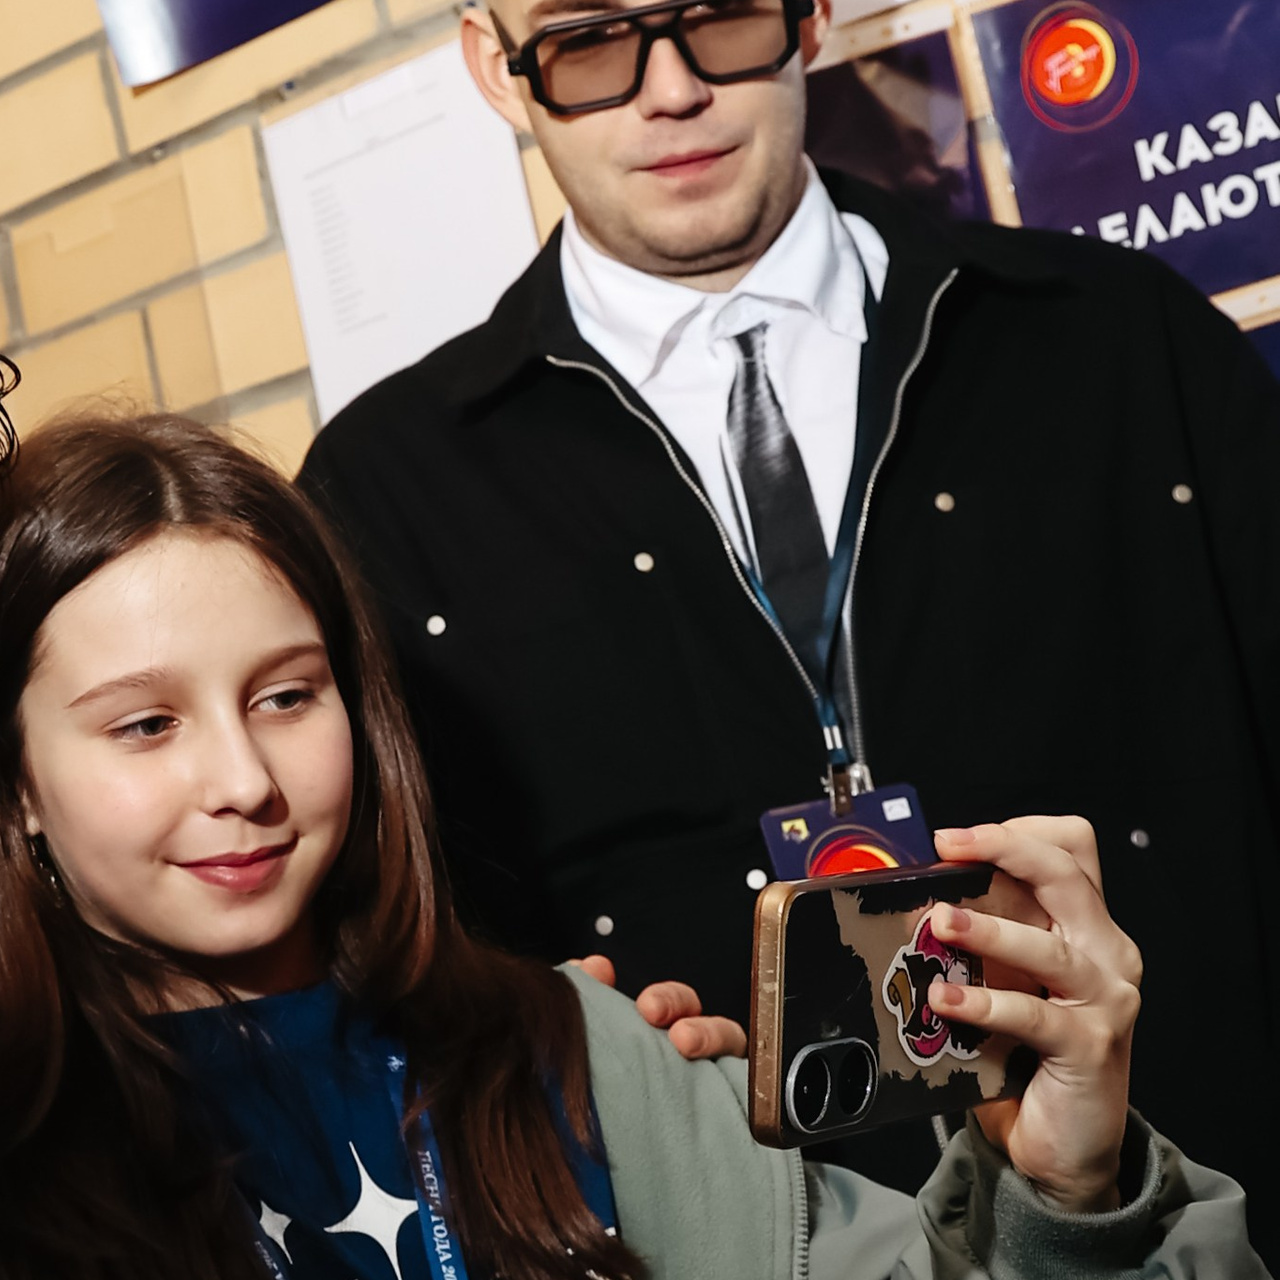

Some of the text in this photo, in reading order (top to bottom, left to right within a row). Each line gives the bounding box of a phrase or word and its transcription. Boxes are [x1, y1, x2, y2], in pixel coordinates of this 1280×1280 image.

[1134, 92, 1280, 182] КАЗА
[1071, 161, 1280, 250] ЕЛАЮТ
[430, 1214, 453, 1263] ГОДА
